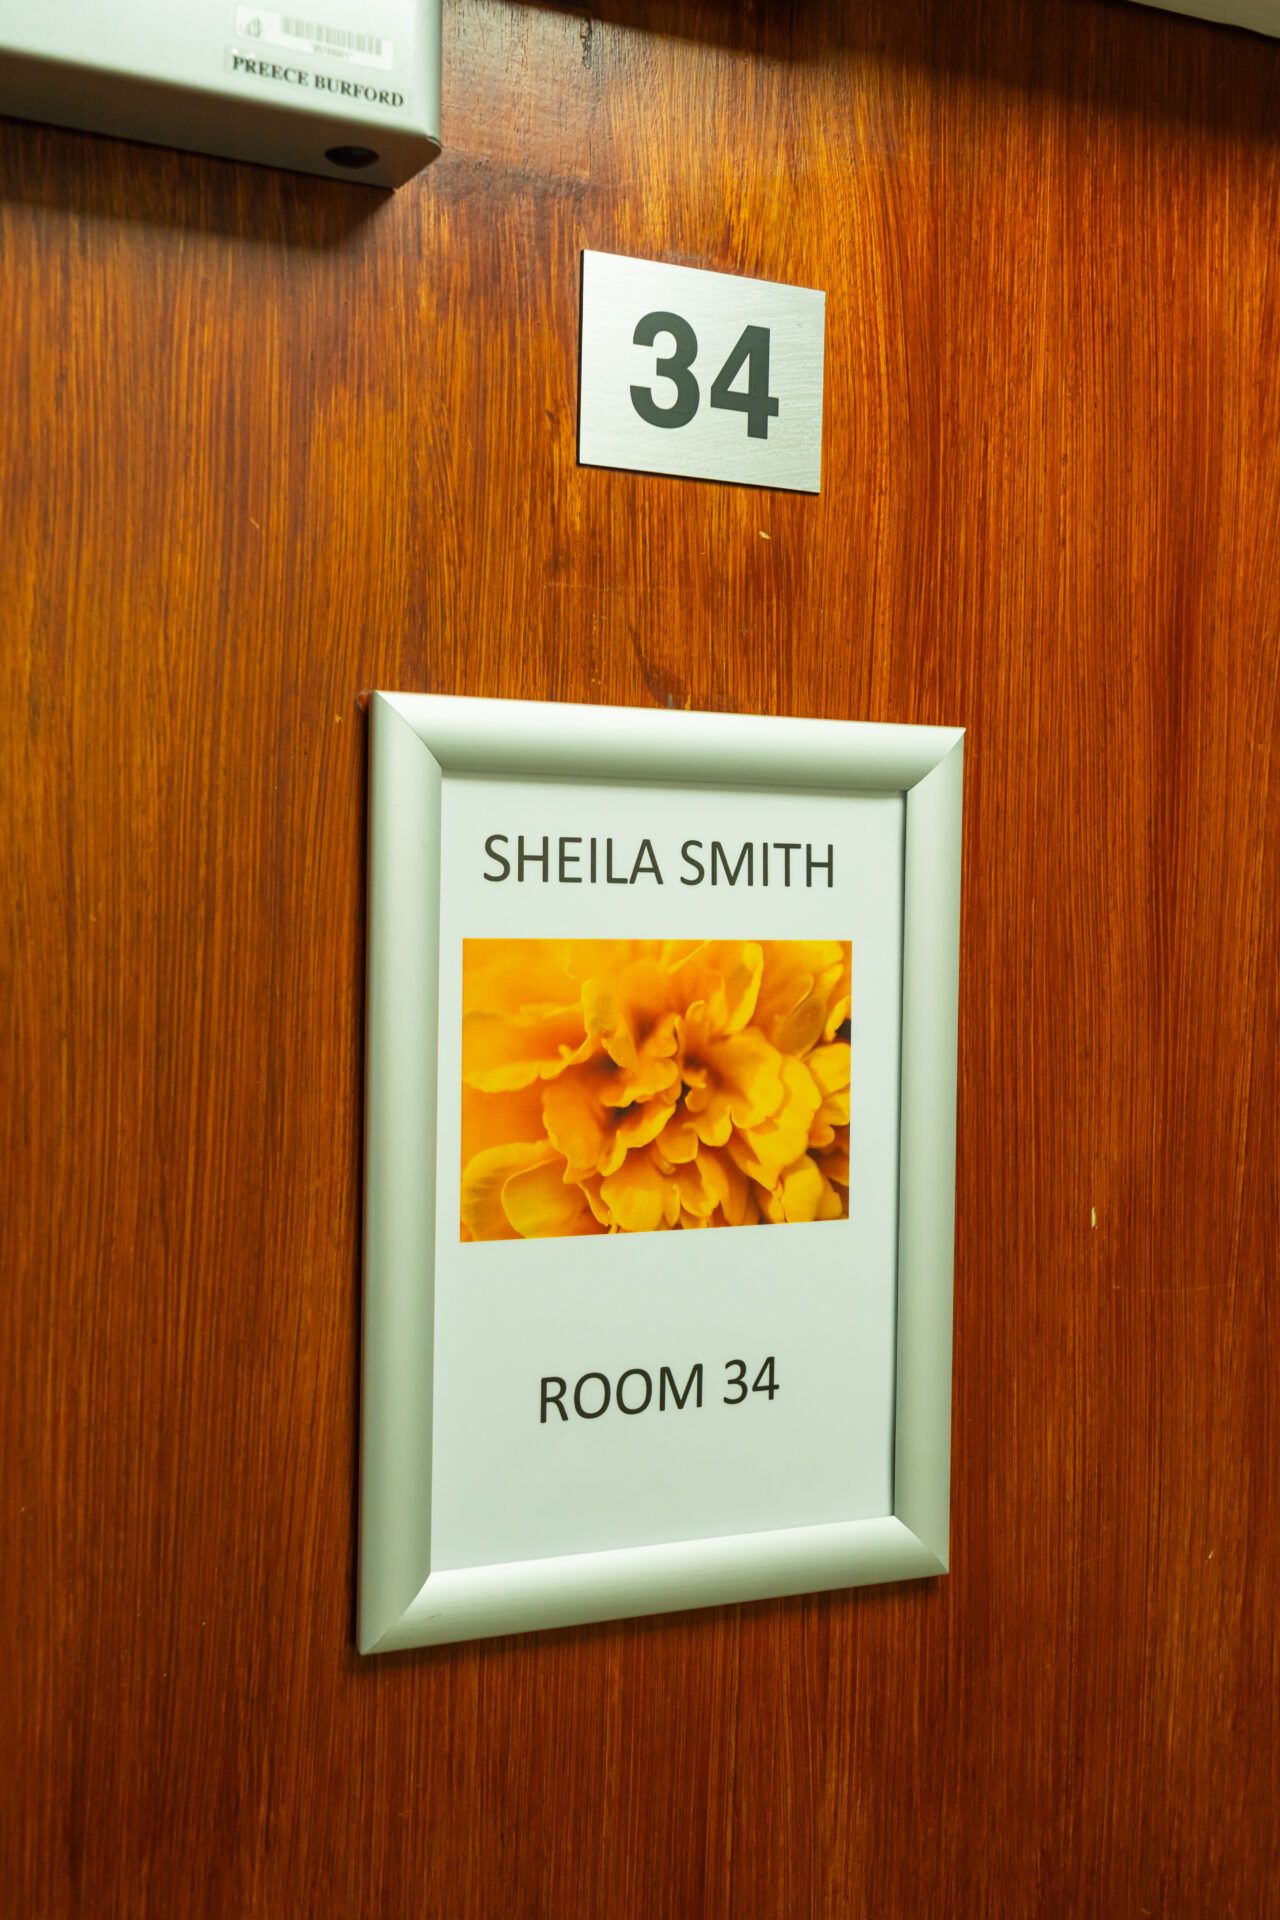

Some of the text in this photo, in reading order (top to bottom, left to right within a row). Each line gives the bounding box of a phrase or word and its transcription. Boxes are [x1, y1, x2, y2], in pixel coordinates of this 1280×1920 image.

[233, 55, 404, 107] PREECE BURFORD
[629, 311, 779, 440] 34
[483, 834, 834, 888] SHEILA SMITH
[540, 1356, 780, 1423] ROOM 34
